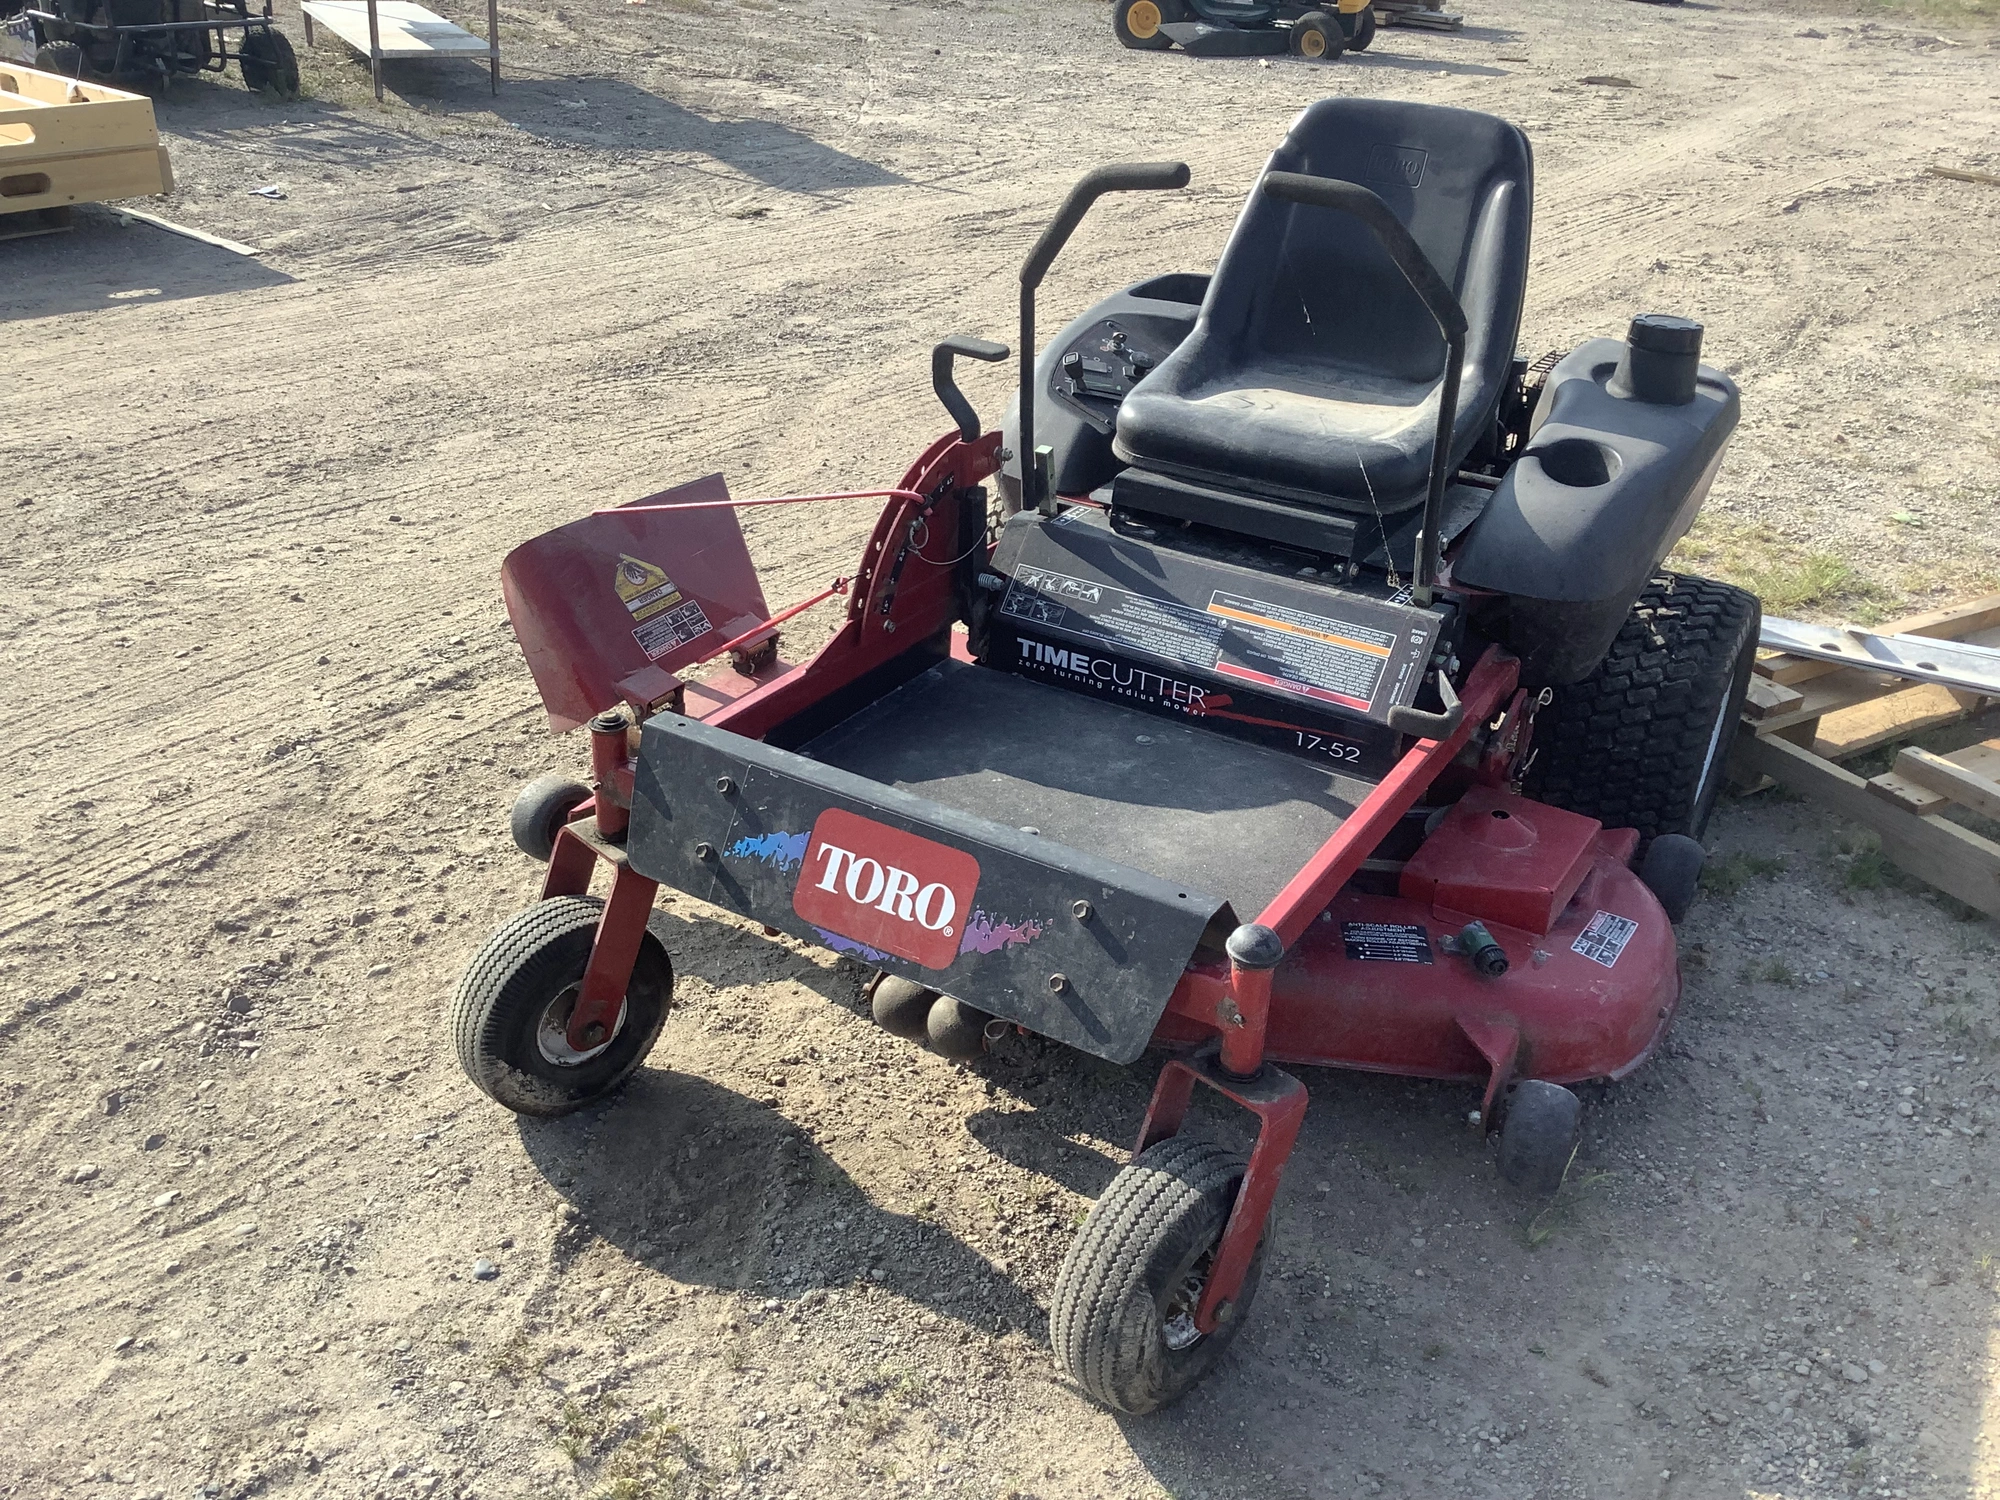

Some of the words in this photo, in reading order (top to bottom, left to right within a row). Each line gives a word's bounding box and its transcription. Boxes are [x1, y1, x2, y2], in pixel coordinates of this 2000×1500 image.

[638, 588, 663, 604] DANGER
[1290, 625, 1321, 638] WARNING
[1018, 659, 1046, 672] zero
[1053, 668, 1103, 689] turning
[1111, 685, 1154, 703] radius
[1163, 699, 1206, 717] mower
[1273, 677, 1302, 690] DANGER
[1296, 732, 1360, 763] 17-52
